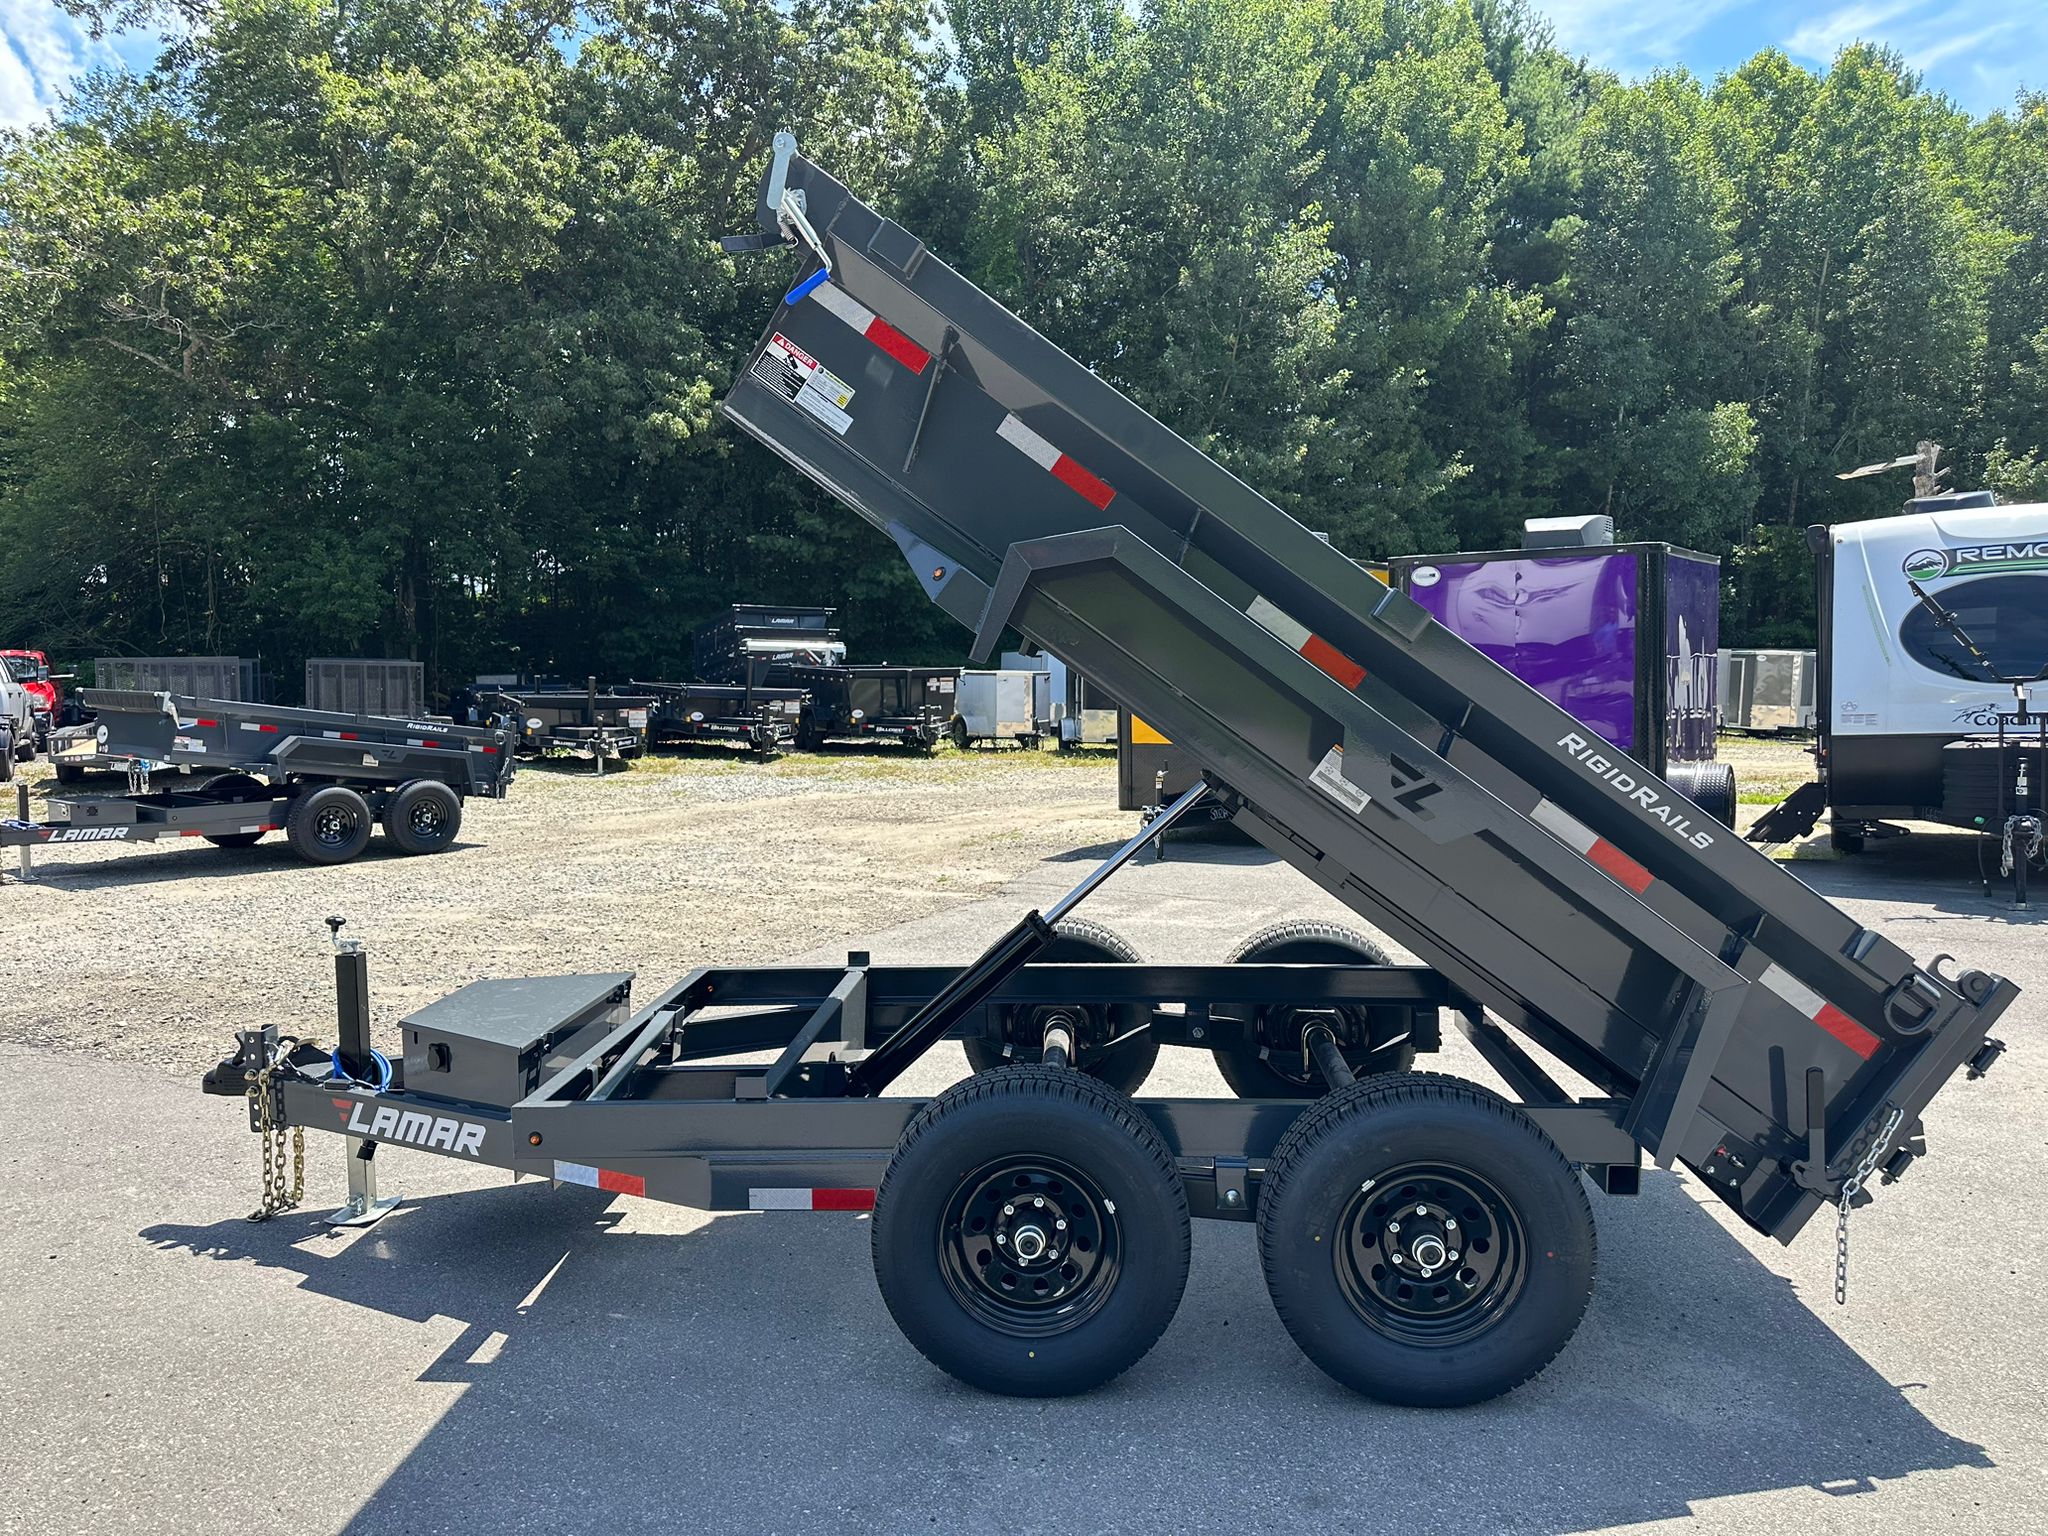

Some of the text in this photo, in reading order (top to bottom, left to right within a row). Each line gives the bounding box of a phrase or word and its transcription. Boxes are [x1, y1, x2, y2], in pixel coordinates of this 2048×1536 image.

[784, 342, 814, 366] DANGER
[1556, 732, 1714, 850] RIGIDRAILS
[47, 827, 130, 842] LAMAR
[347, 1101, 487, 1157] LAMAR
